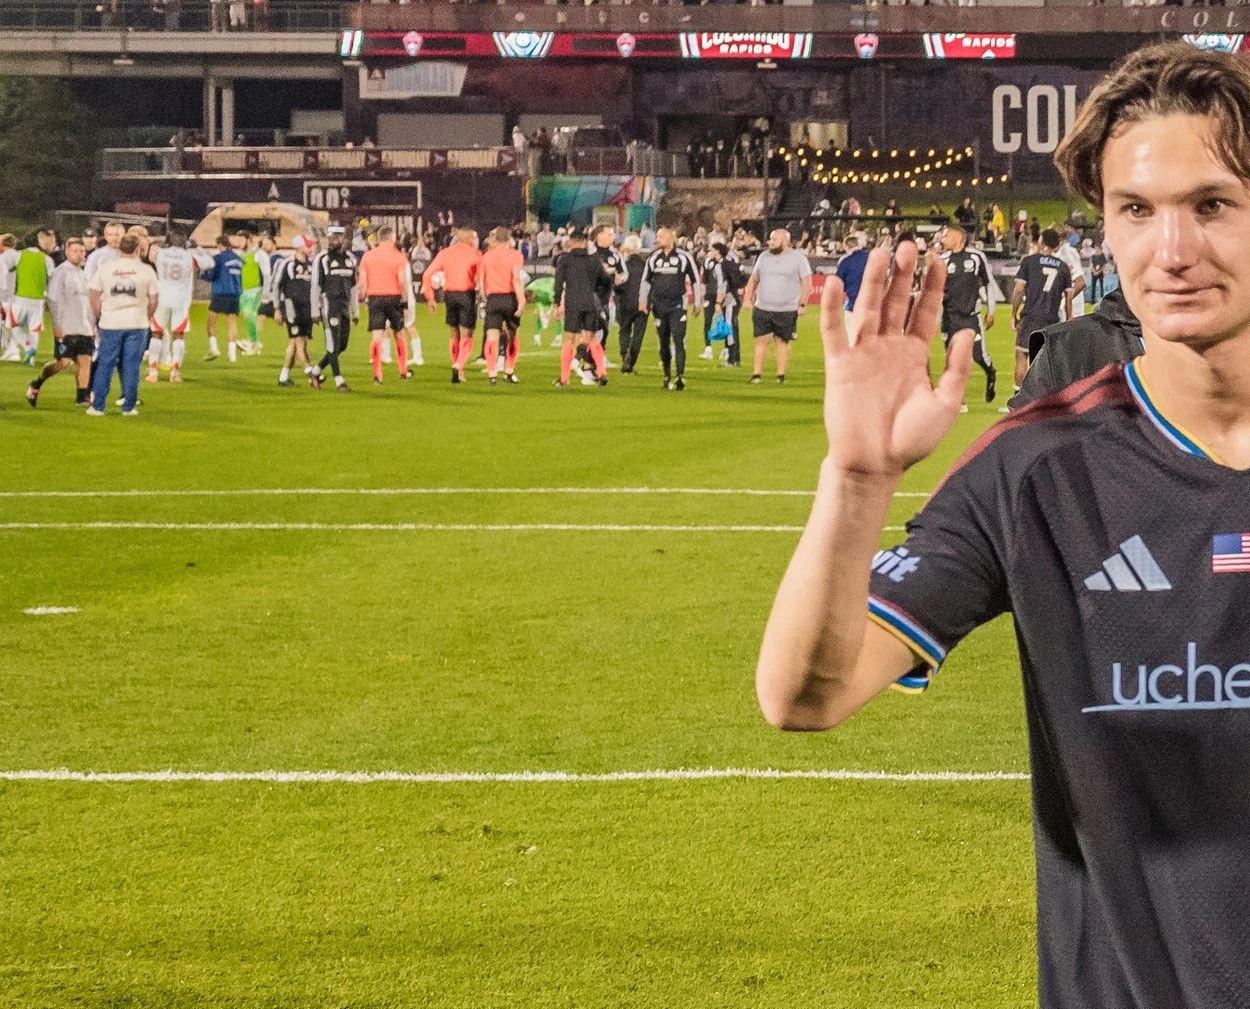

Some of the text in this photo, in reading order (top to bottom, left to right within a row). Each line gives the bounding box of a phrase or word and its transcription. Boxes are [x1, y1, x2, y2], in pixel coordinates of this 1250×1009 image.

[961, 37, 1016, 48] RAPIDS
[719, 43, 773, 54] RAPIDS
[1042, 266, 1059, 292] 7
